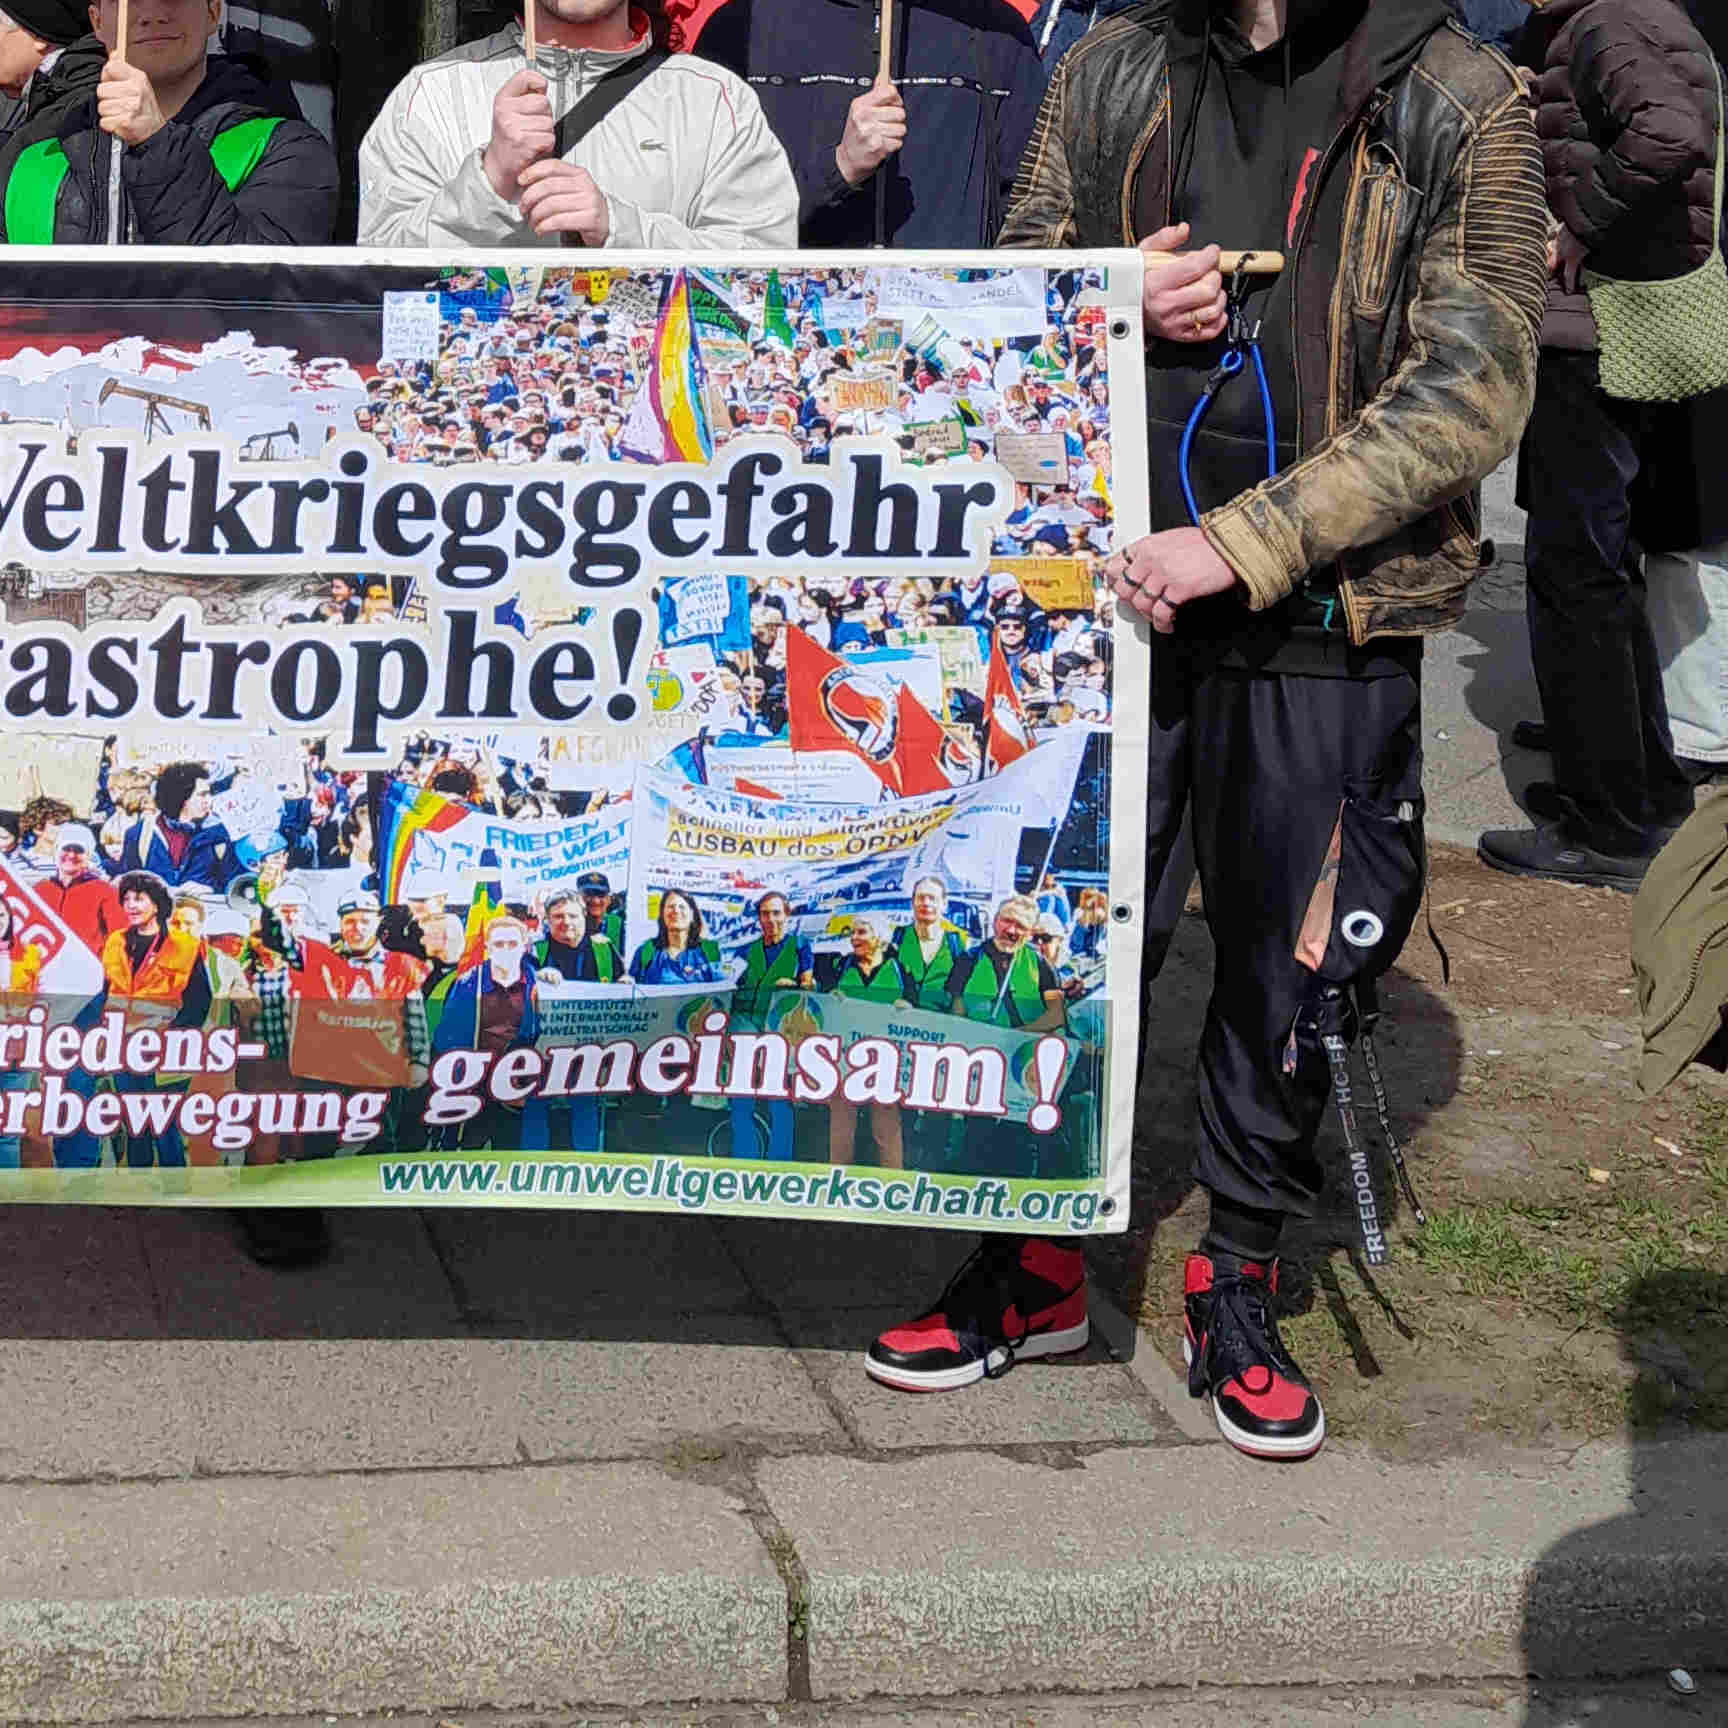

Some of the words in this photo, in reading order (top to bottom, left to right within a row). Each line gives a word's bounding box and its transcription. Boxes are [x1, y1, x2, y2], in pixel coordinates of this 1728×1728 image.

[485, 817, 600, 853] FRIEDEN
[562, 816, 633, 861] WELT
[667, 830, 777, 857] AUSBAU
[887, 1023, 946, 1044] SUPPORT
[380, 1158, 1100, 1229] www.umweltgewerkschaft.org
